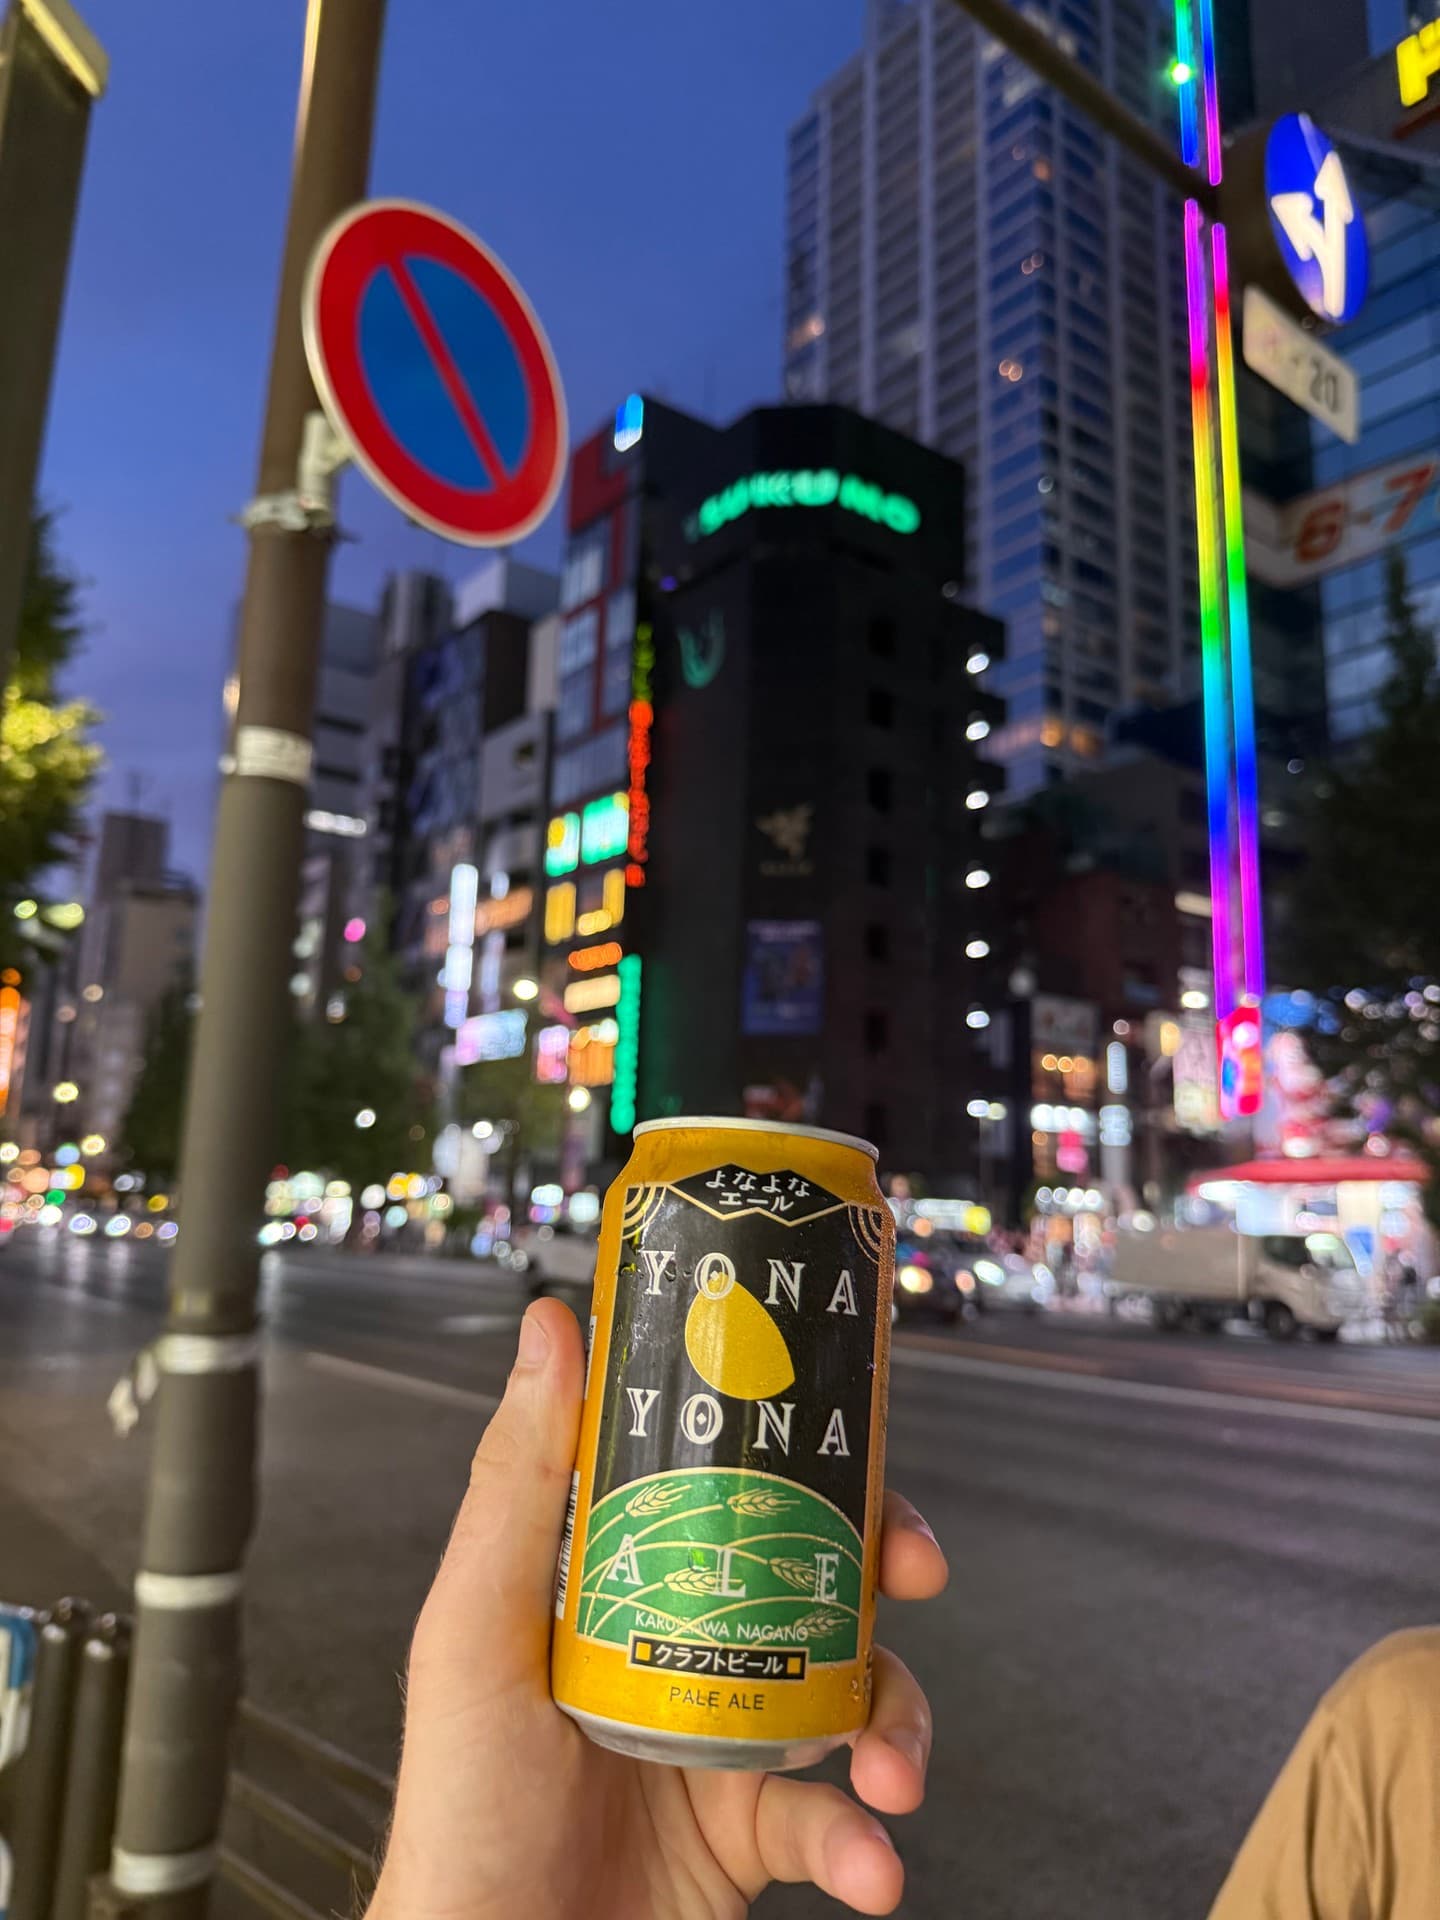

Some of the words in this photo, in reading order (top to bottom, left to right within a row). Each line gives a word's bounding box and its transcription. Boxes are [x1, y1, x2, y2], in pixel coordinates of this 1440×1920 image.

[705, 1169, 811, 1198] よなよな
[718, 1190, 795, 1212] エール
[639, 1250, 859, 1316] YONA
[626, 1386, 851, 1456] YONA
[607, 1533, 840, 1603] ALE
[736, 1623, 809, 1642] NAGANO
[654, 1643, 784, 1674] クラフトビール
[669, 1686, 721, 1708] PALE
[728, 1692, 765, 1711] ALE
